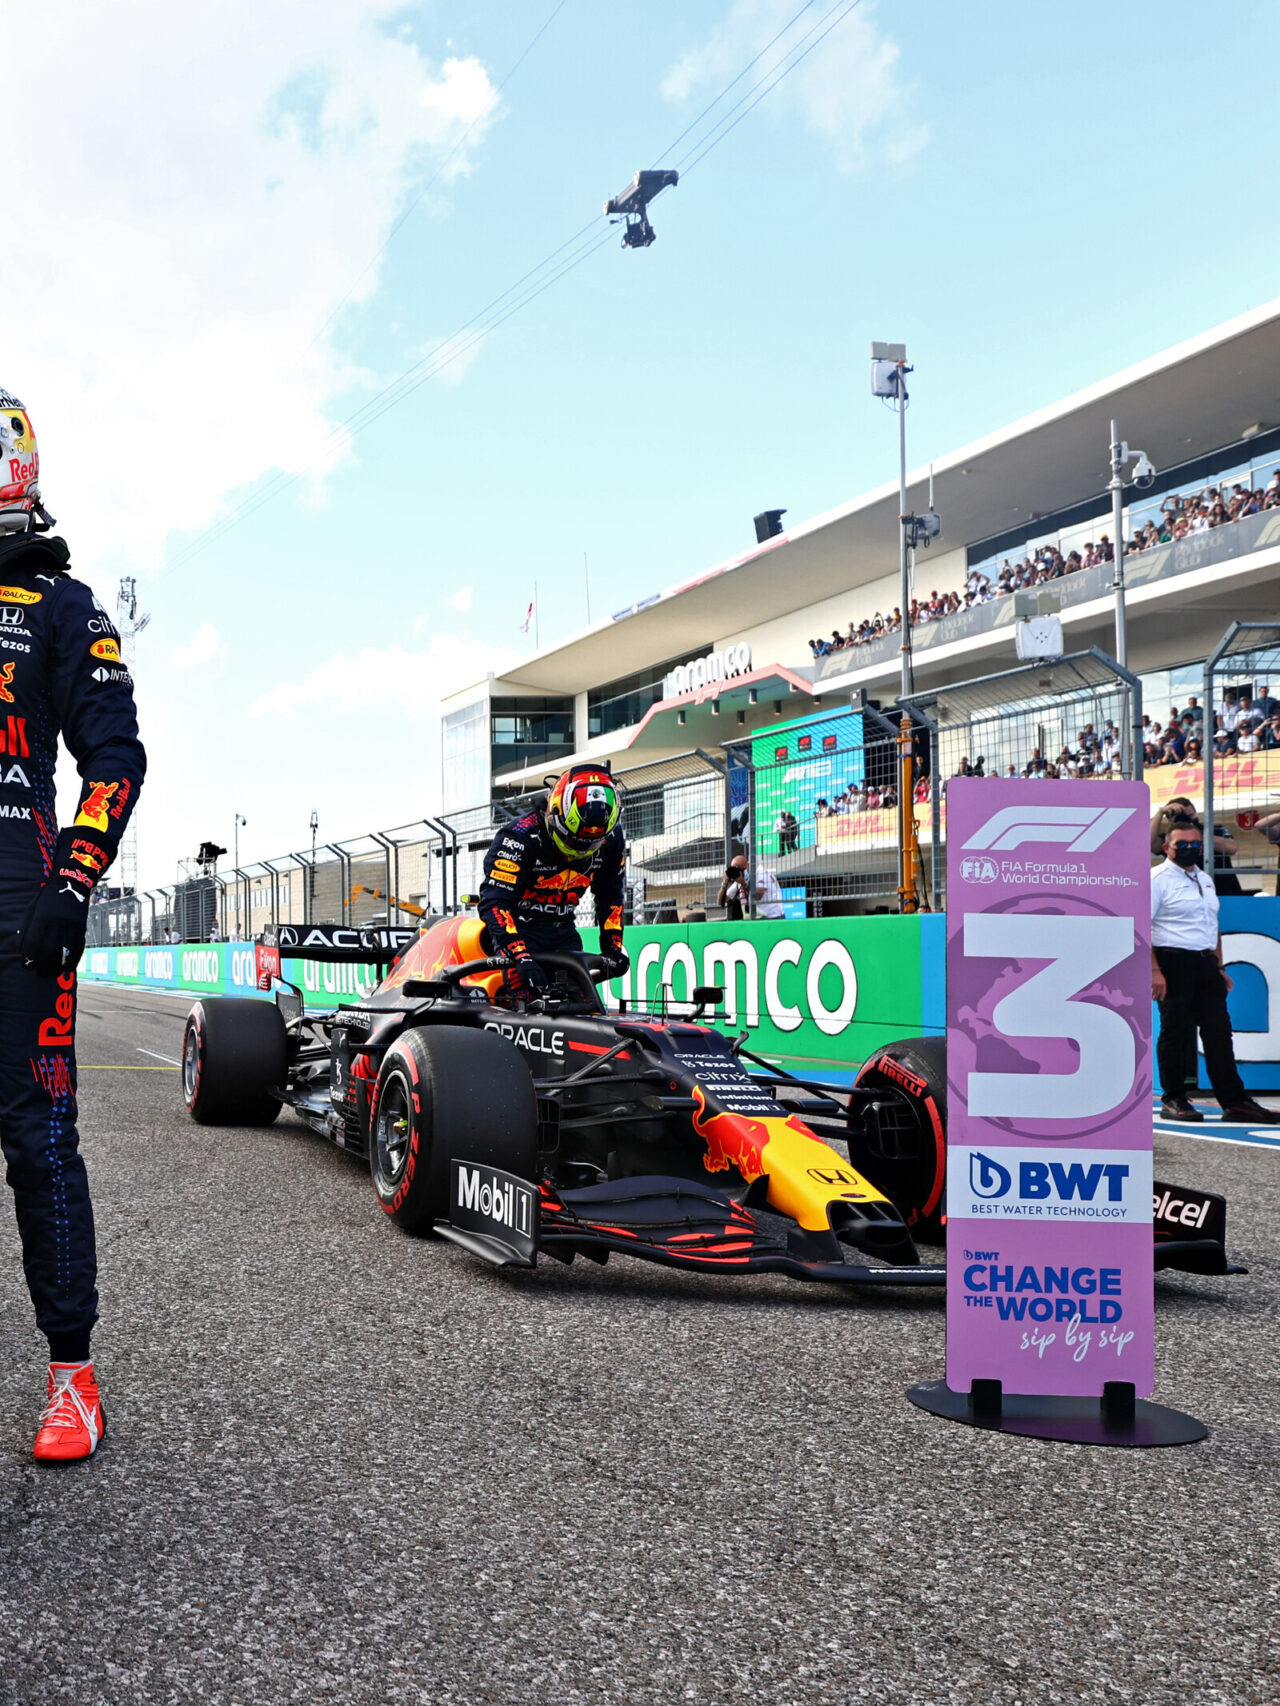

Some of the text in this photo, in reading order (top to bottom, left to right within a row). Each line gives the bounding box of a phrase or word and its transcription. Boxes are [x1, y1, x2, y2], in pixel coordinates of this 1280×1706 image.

[1, 589, 37, 602] RAUCH
[959, 805, 1138, 853] F1
[1001, 861, 1088, 874] FIA Formula 1
[1001, 873, 1040, 885] World
[182, 950, 220, 984] aramco
[963, 912, 1136, 1120] 3
[877, 1055, 928, 1097] PIRELLI
[726, 1103, 770, 1111] Mobil
[457, 1165, 514, 1228] Mobil
[1019, 1161, 1130, 1202] BWT
[971, 1203, 1128, 1218] BEST WATER TECHNOLOGY
[974, 1251, 1000, 1261] BWT
[963, 1264, 1122, 1296] CHANGE
[963, 1295, 1123, 1324] THE WORLD
[1019, 1312, 1135, 1363] sip by sip
